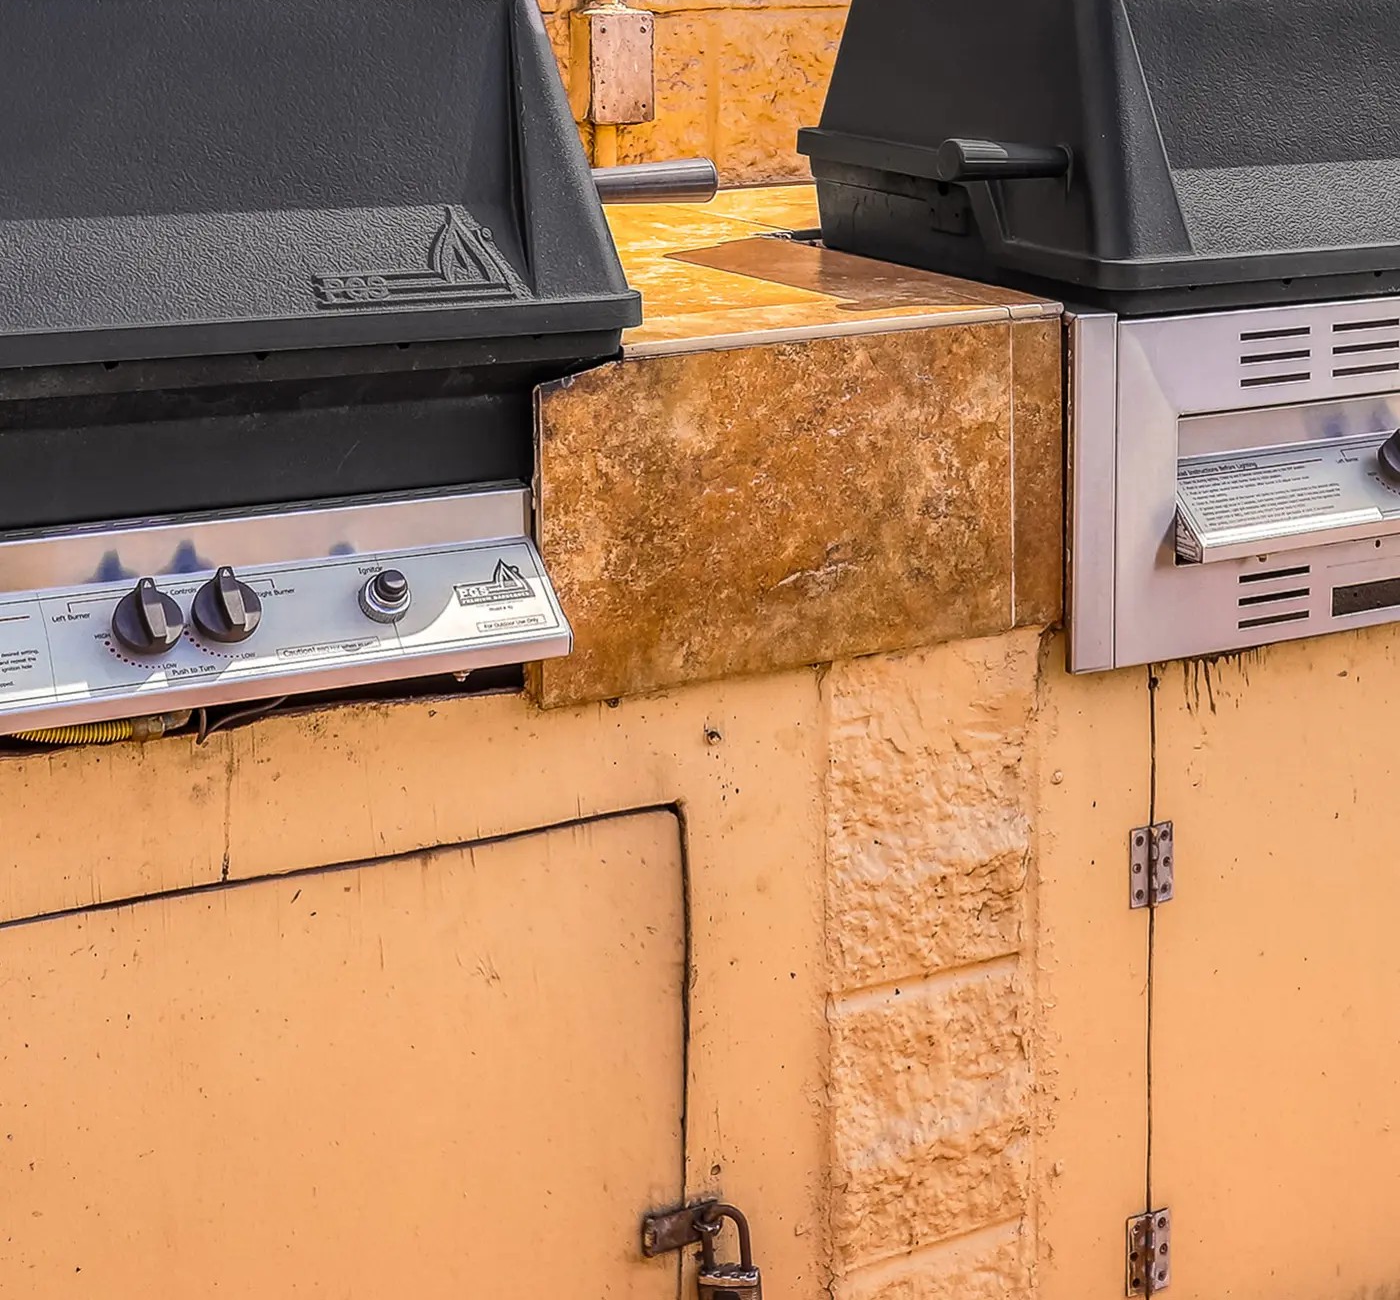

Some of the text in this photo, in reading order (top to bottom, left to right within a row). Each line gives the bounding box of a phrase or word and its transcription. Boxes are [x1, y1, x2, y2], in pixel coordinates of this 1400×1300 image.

[358, 565, 383, 575] Ignitor
[169, 588, 197, 596] Controls
[273, 588, 295, 596] Burner
[459, 586, 489, 599] PGS
[52, 612, 91, 623] Left Burner
[94, 632, 112, 640] HIGH
[172, 668, 189, 676] Push
[199, 664, 216, 672] Turn
